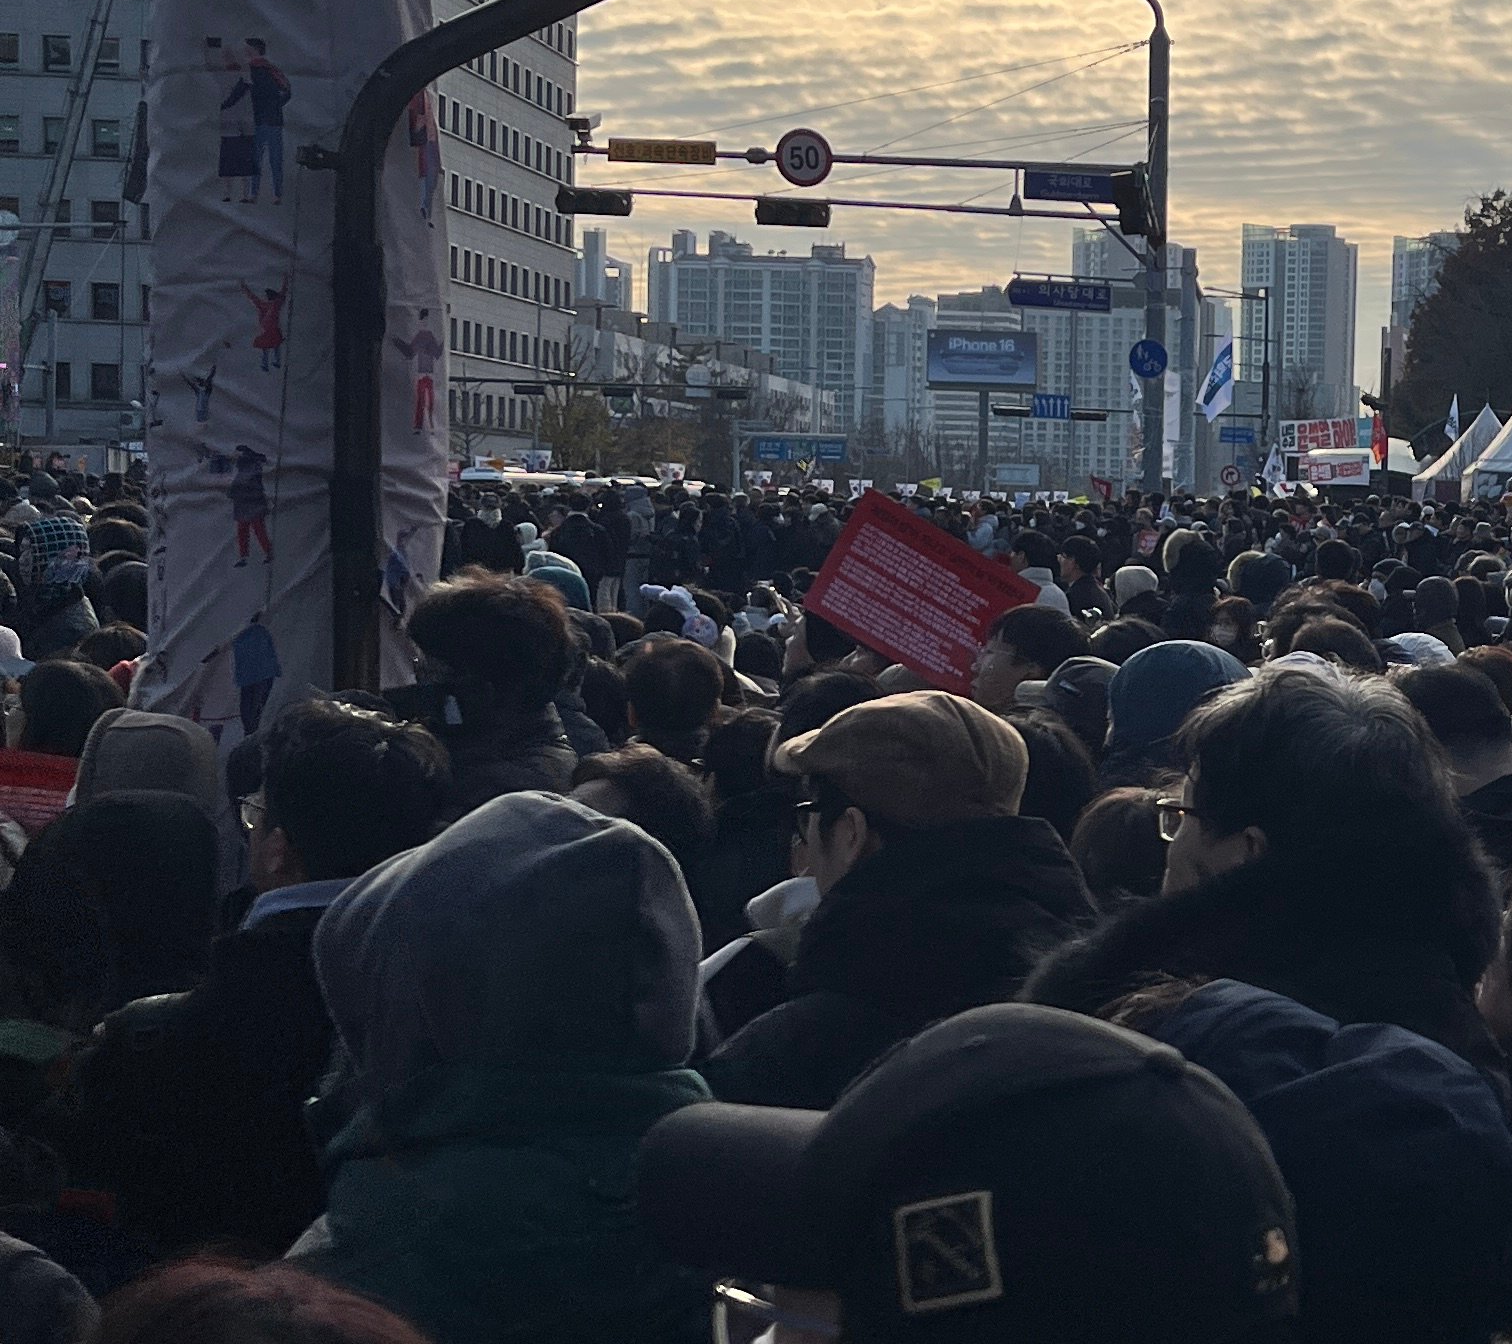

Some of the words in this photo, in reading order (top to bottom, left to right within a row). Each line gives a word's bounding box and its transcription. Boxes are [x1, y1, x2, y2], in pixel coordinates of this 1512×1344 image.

[790, 145, 820, 171] 50
[1047, 174, 1094, 189] 국회대로
[1038, 284, 1109, 300] 의사당대로
[948, 336, 997, 351] iPhone
[999, 339, 1015, 352] 16
[1297, 421, 1331, 451] 윤석열
